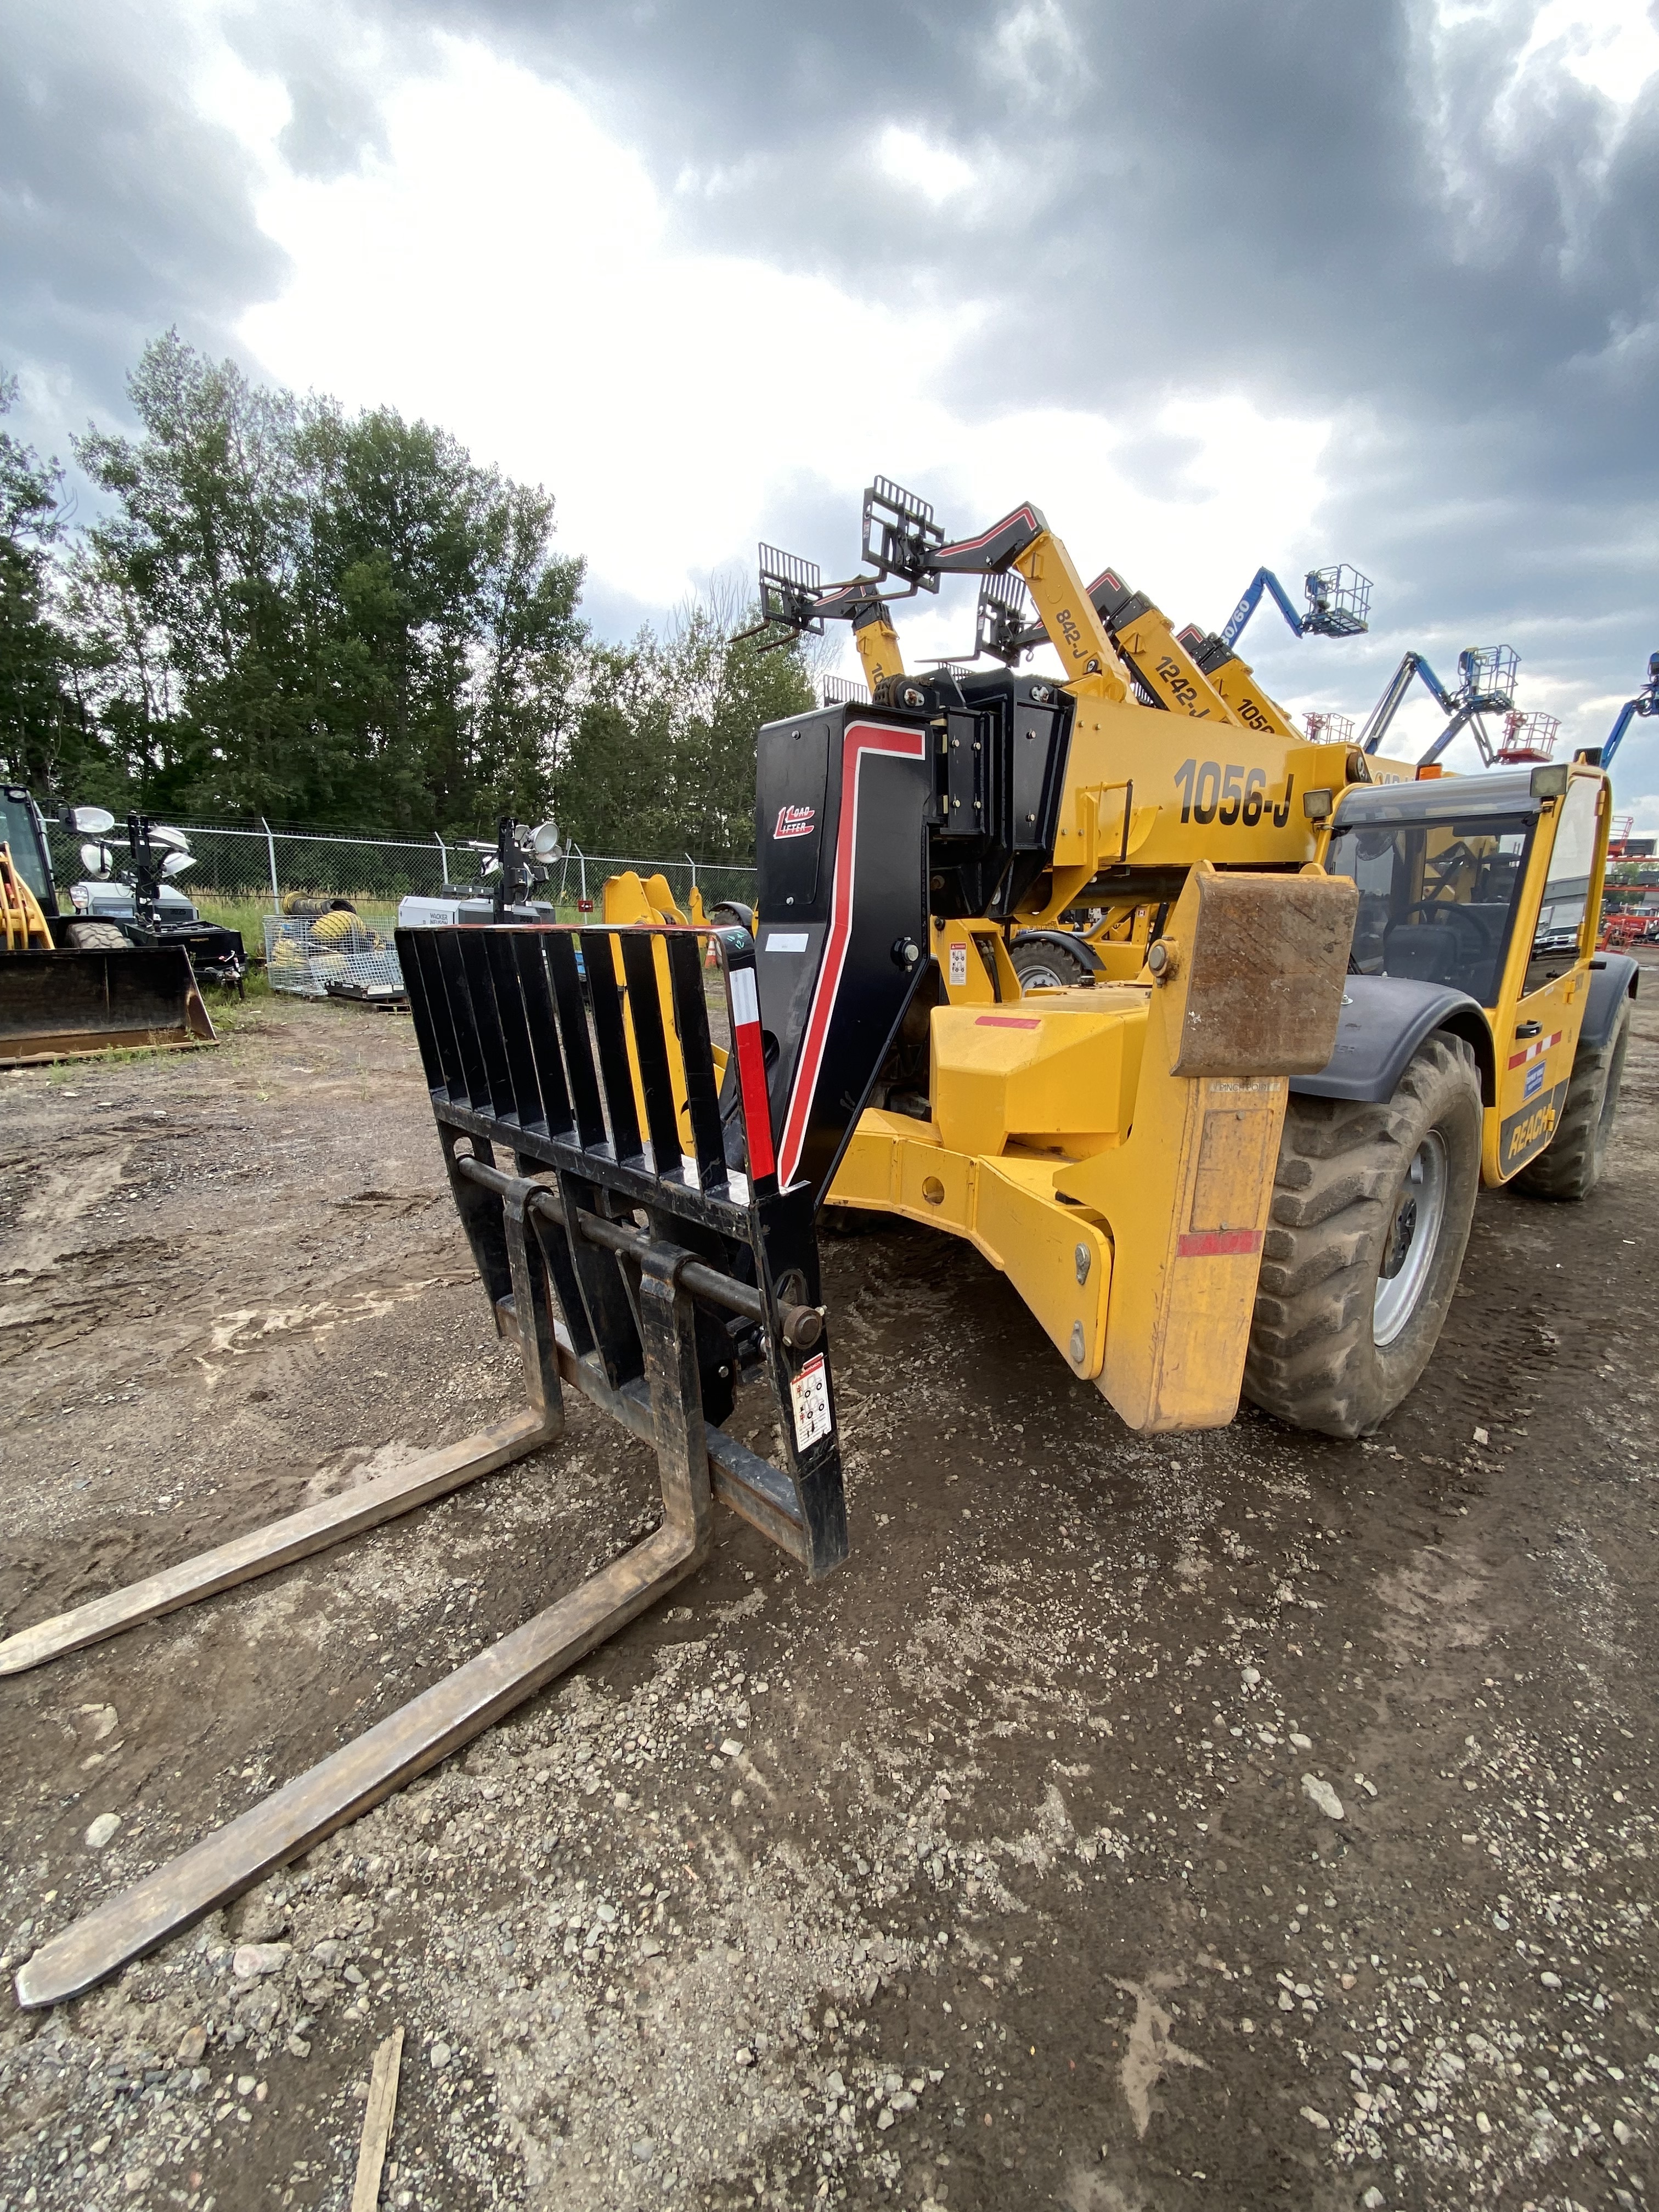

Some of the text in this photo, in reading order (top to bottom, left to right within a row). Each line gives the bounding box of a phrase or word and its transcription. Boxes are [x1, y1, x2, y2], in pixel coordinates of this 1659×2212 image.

[1056, 609, 1088, 659] 842-J
[1155, 656, 1211, 719] 1242-J
[785, 805, 815, 823] LOAD
[1173, 758, 1295, 828] 1056-J
[773, 806, 815, 840] LIFTER
